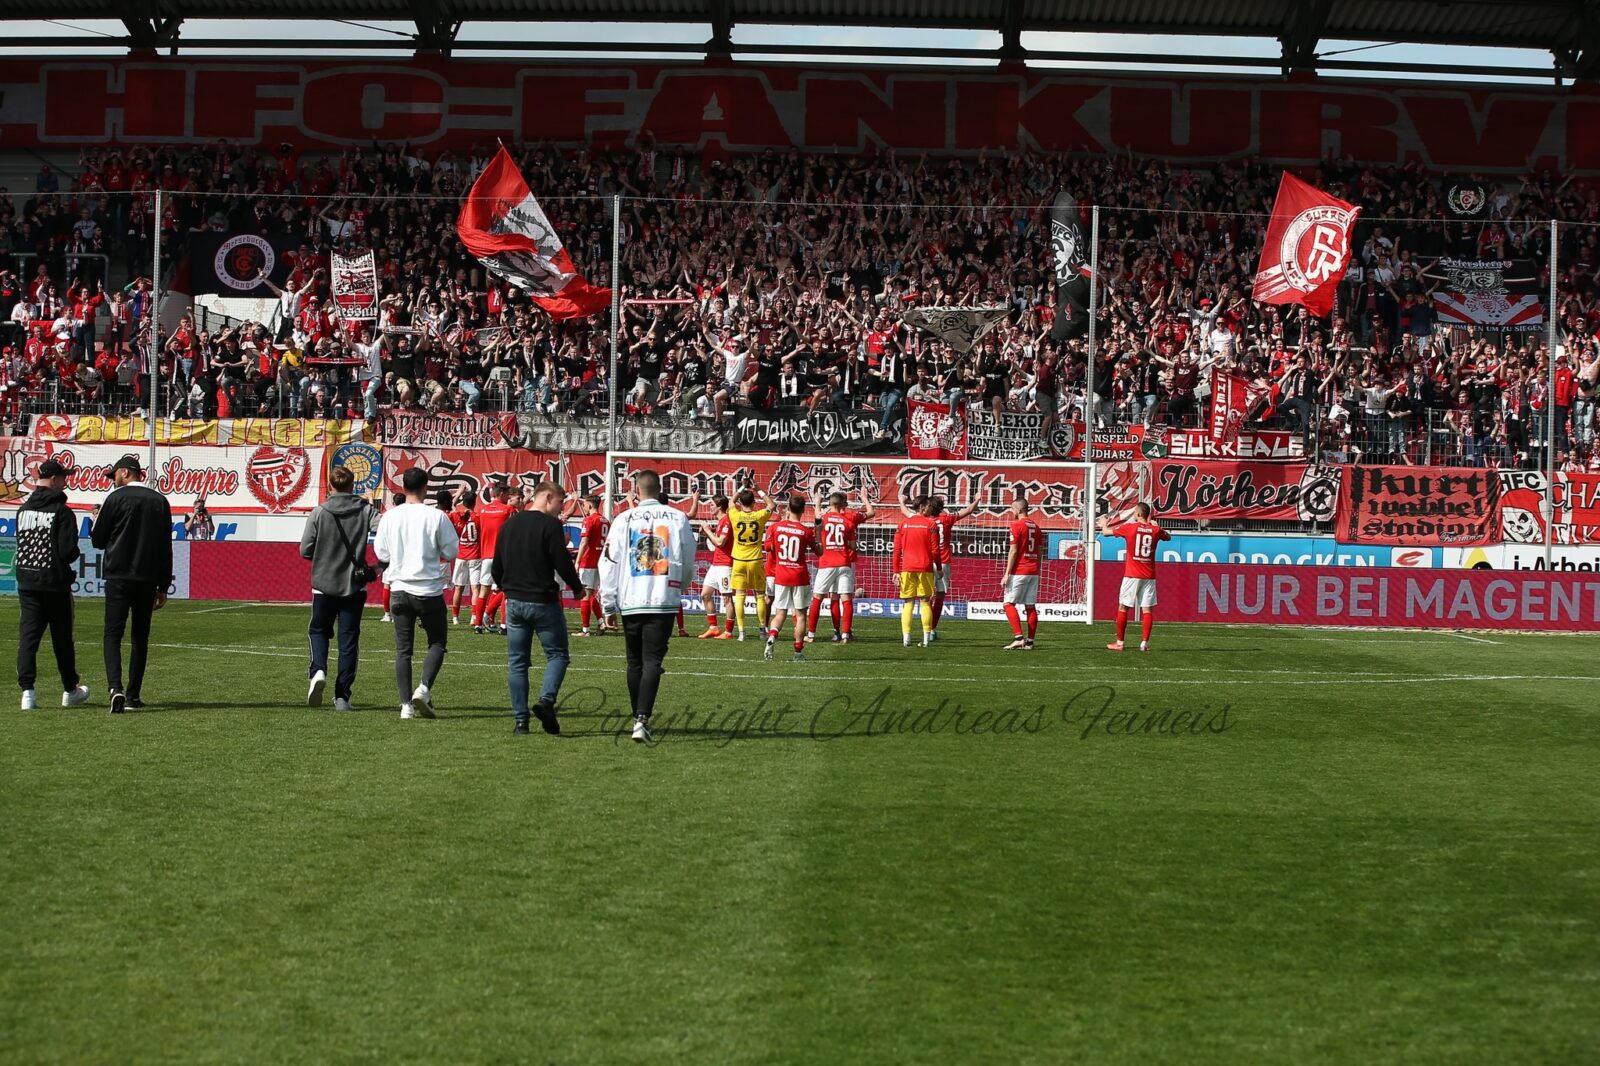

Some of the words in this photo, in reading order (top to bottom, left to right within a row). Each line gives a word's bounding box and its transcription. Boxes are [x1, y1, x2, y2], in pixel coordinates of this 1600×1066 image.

[1439, 256, 1503, 270] Petersberg
[1501, 325, 1513, 333] ZU
[1515, 324, 1544, 332] SIEGEN
[229, 417, 353, 447] JAGEN
[757, 418, 811, 444] JAHRE
[813, 413, 836, 443] 19
[840, 417, 902, 441] ULTRS
[1078, 433, 1139, 445] MNSFELD
[419, 433, 497, 448] Leidenschaft
[1170, 433, 1304, 457] SURREALE
[968, 447, 994, 459] NICHT
[994, 447, 1050, 460] AKZEPTIEREN
[158, 456, 239, 504] Sempre
[814, 466, 838, 476] HFC
[1500, 472, 1541, 492] HFC
[897, 464, 1110, 517] Ultras
[1152, 464, 1302, 514] Köthen
[736, 521, 760, 543] 23
[824, 523, 846, 546] 26
[1028, 528, 1036, 552] 5
[777, 534, 801, 562] 30
[967, 539, 1007, 555] dich!
[1134, 533, 1153, 558] 18
[721, 577, 729, 589] 19
[1197, 572, 1301, 616] NUR
[1316, 575, 1388, 618] BEI
[856, 602, 884, 614] PS
[971, 606, 1006, 616] bewe
[1044, 607, 1087, 618] Region
